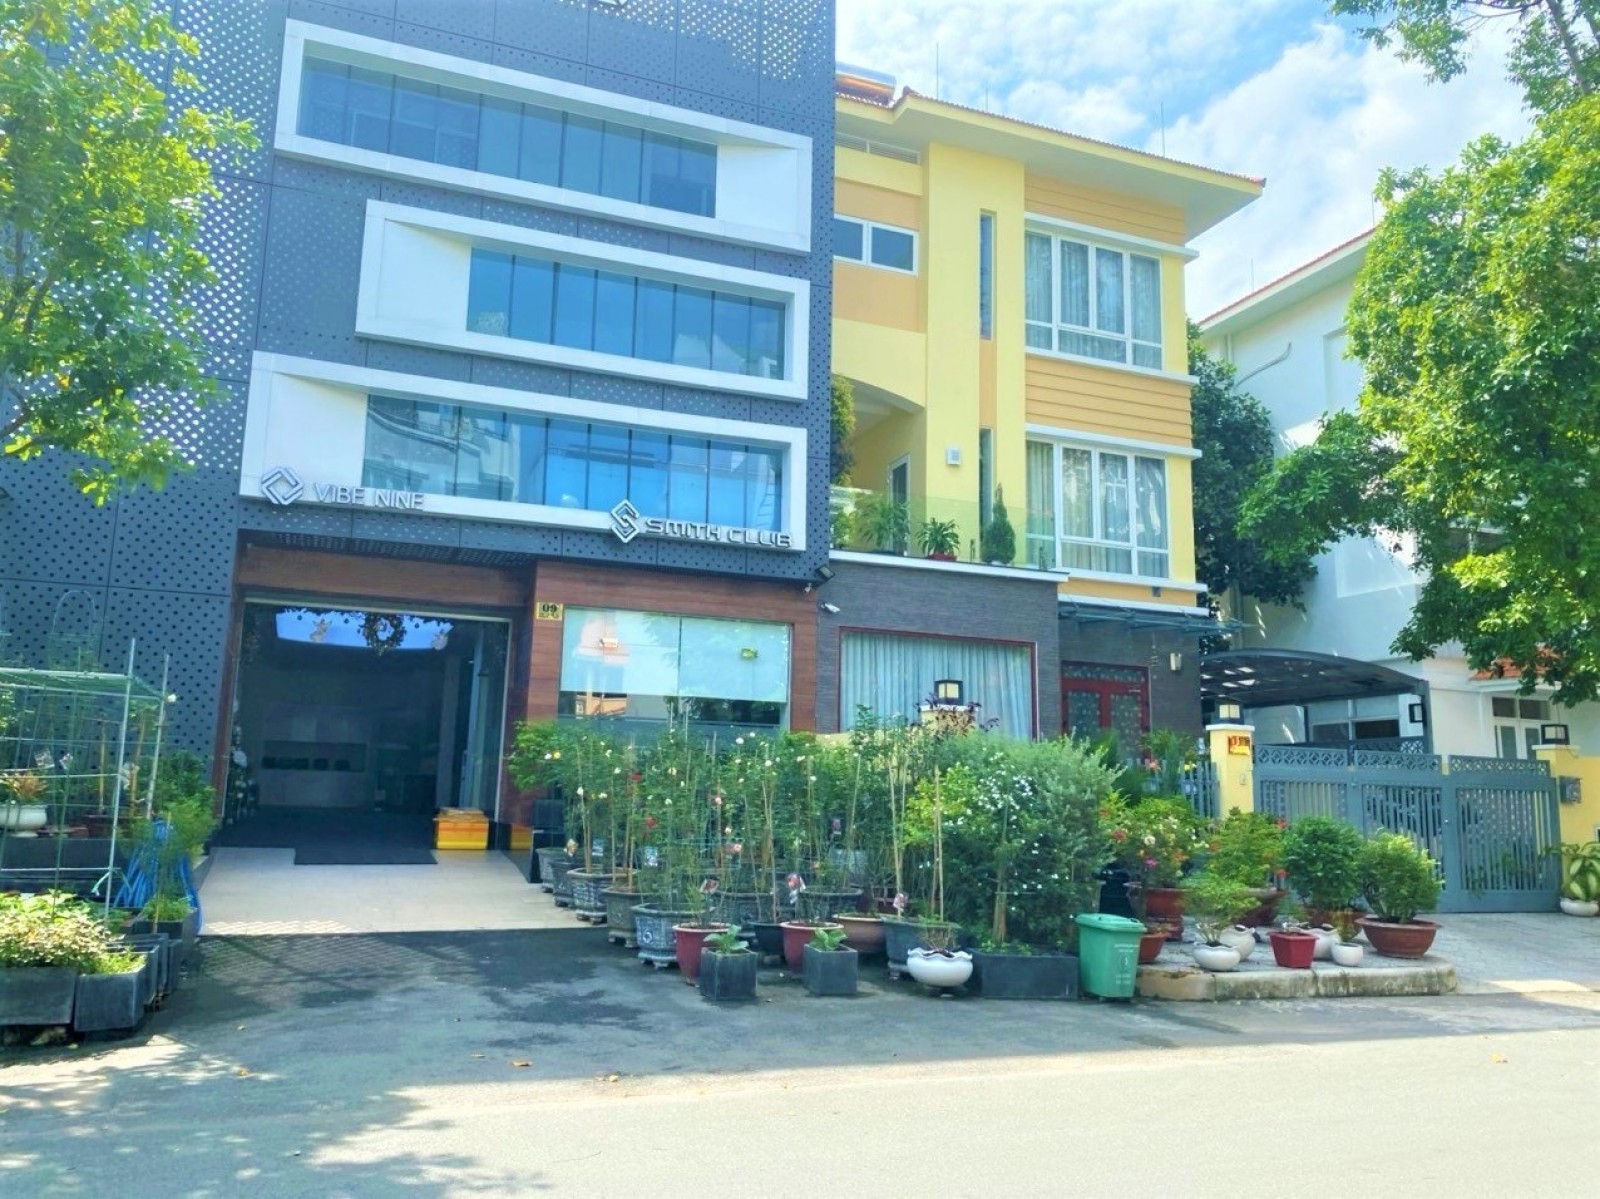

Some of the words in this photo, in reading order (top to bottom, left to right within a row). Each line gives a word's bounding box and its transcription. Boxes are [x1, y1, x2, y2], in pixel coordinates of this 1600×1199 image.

[315, 483, 366, 505] VIBE
[374, 490, 424, 510] NINE
[645, 517, 720, 541] SMITH
[728, 530, 793, 549] CLUB
